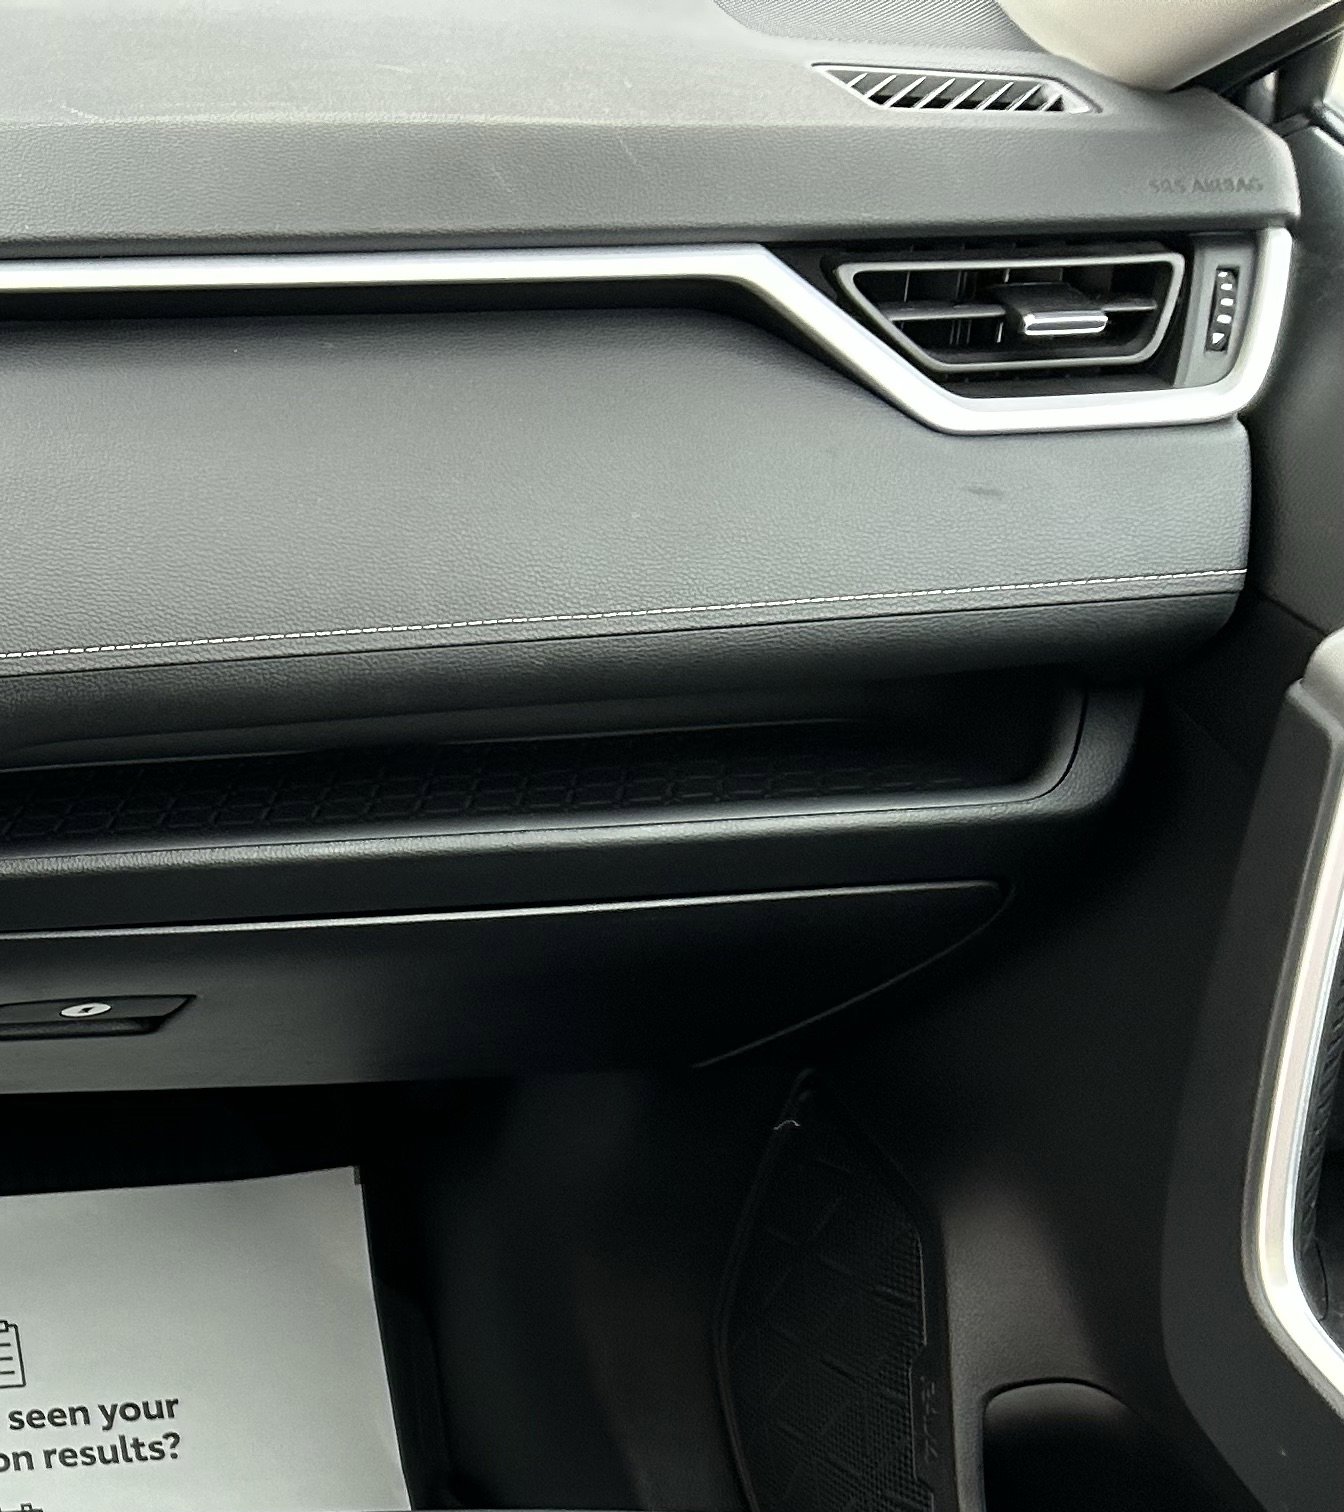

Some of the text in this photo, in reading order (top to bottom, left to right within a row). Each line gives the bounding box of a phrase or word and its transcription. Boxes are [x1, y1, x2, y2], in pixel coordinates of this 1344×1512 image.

[9, 1407, 90, 1430] seen
[98, 1399, 178, 1430] your
[44, 1433, 180, 1468] results?
